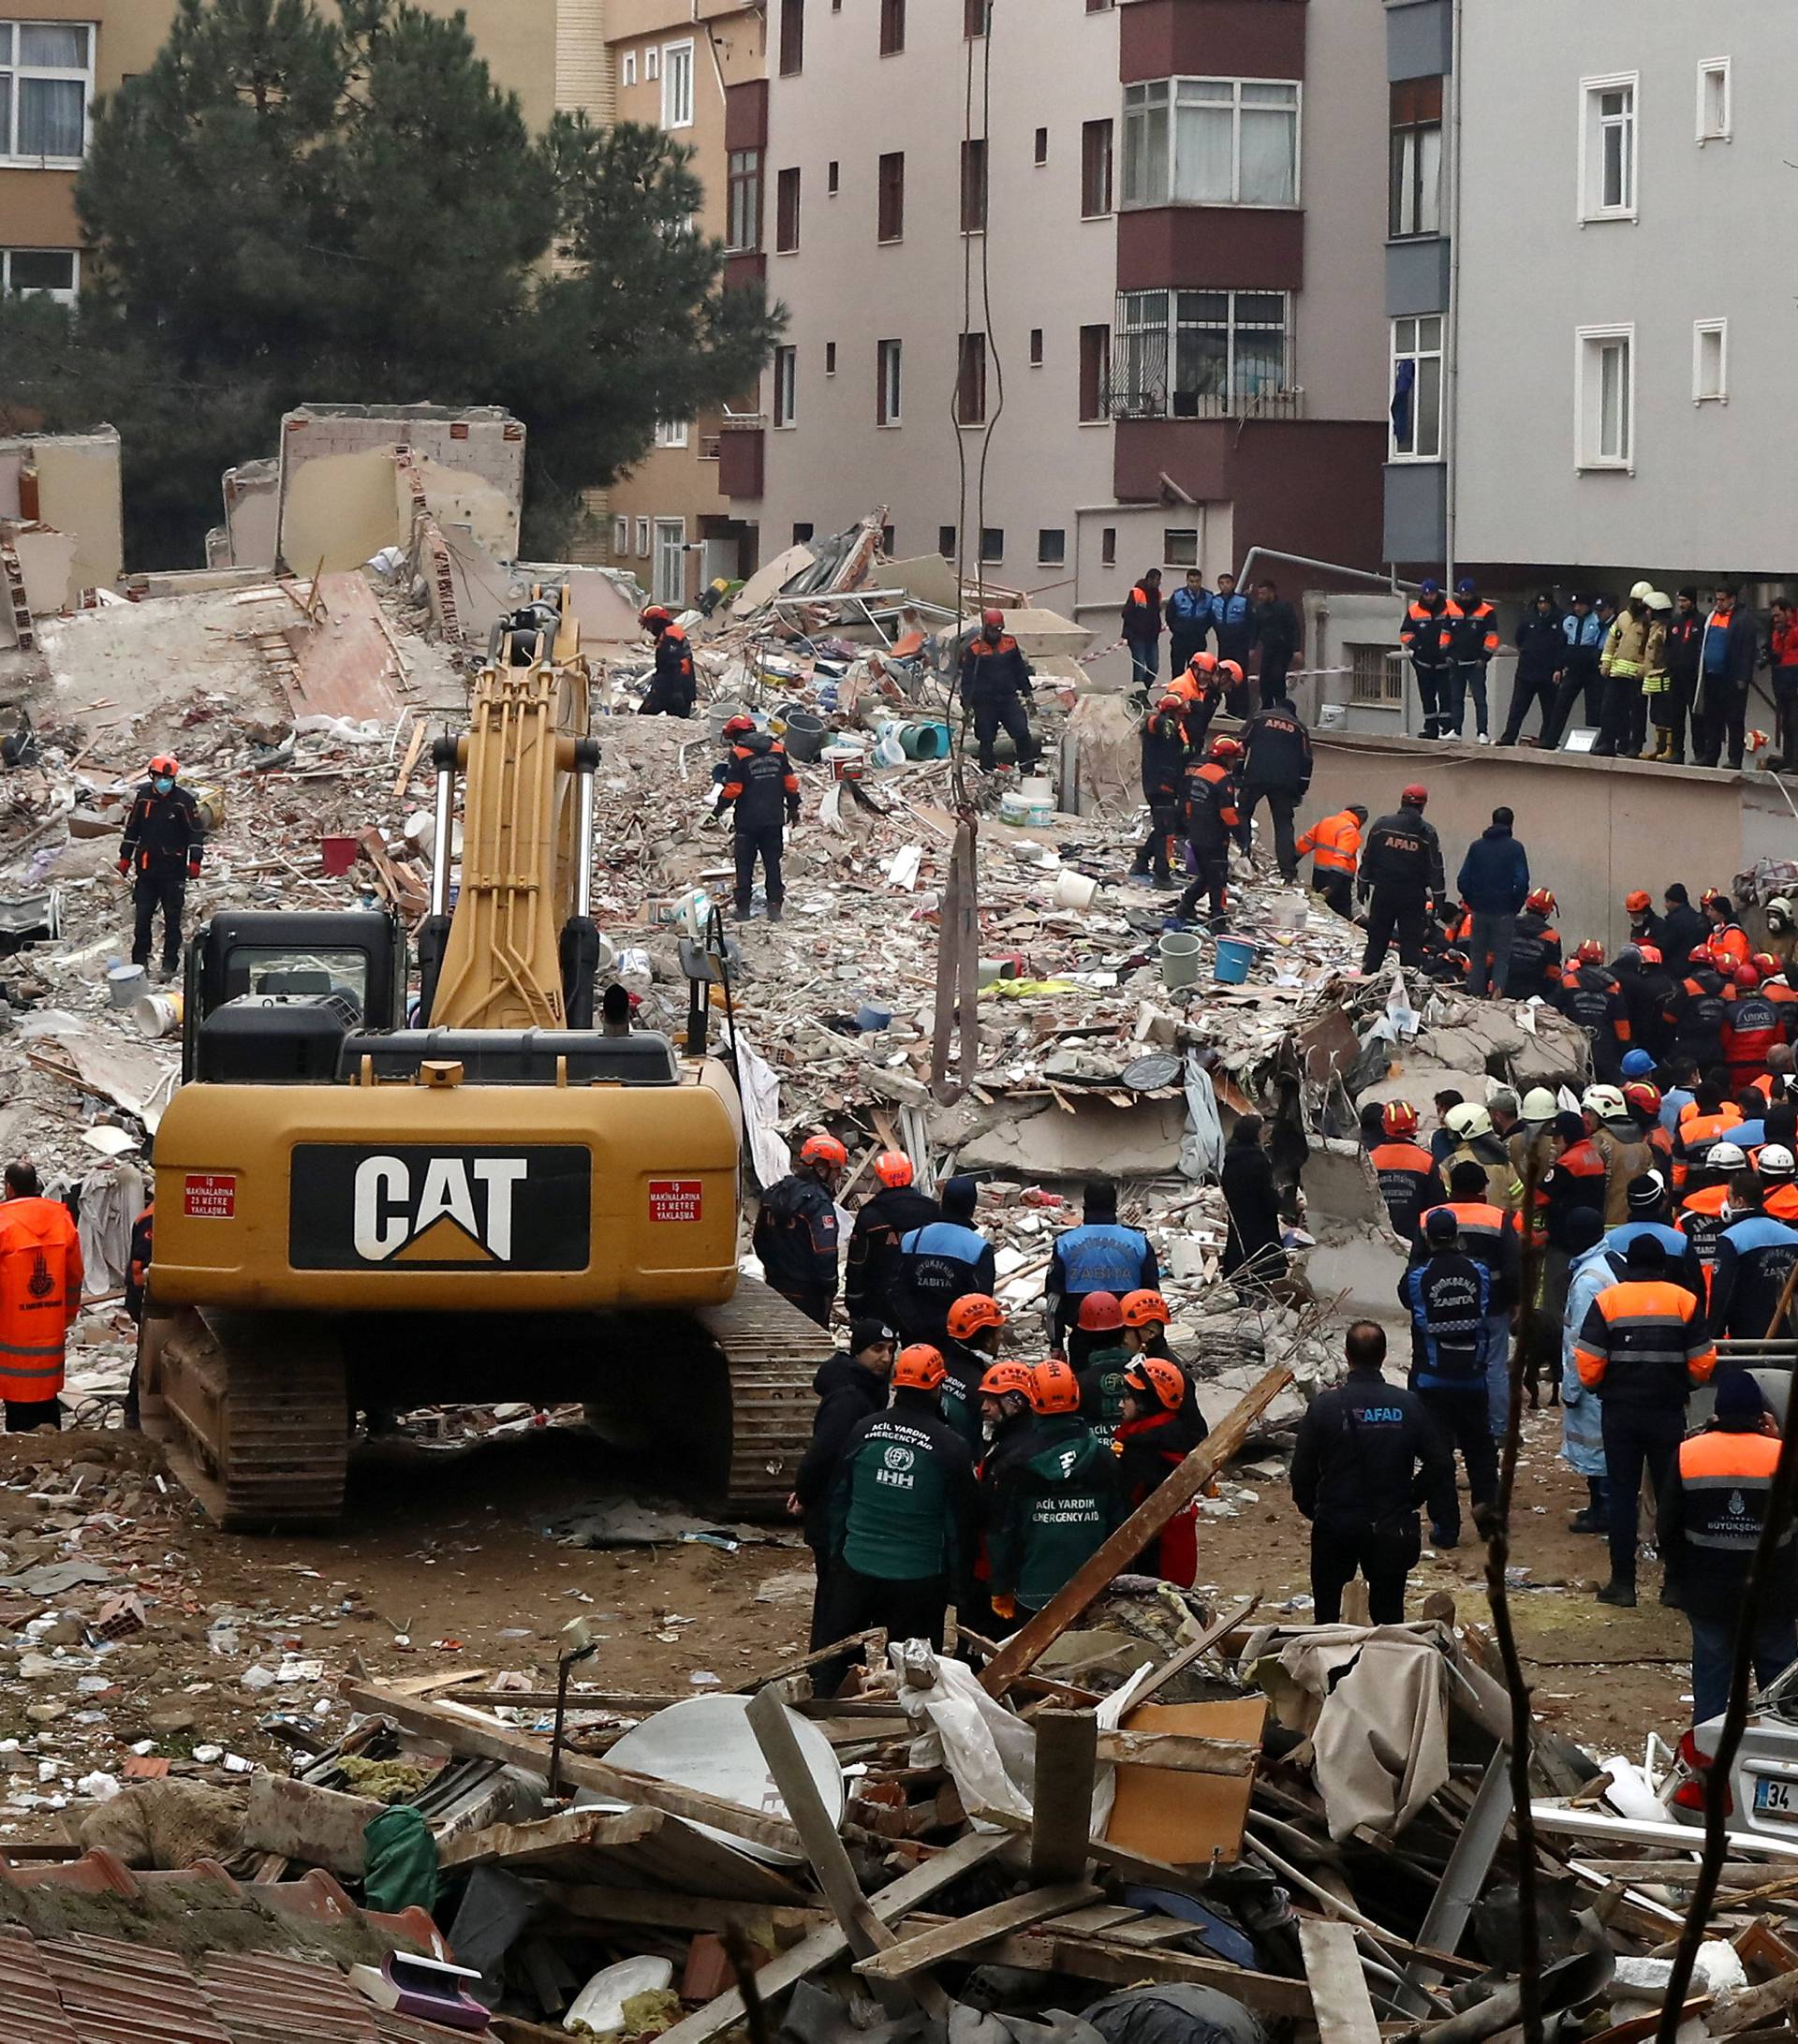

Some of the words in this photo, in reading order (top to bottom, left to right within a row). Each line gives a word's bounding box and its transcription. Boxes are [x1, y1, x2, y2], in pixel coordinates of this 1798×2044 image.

[1385, 836, 1420, 852] AFAD
[201, 1197, 228, 1206] METRE
[354, 1155, 528, 1261] CAT
[656, 1201, 666, 1211] 25
[668, 1201, 695, 1211] METRE
[917, 1277, 952, 1288] ZABITA
[1363, 1407, 1404, 1422] AFAD
[864, 1431, 918, 1444] EMERGENCY
[917, 1440, 934, 1450] AID
[894, 1424, 931, 1442] YARDIM
[1058, 1498, 1095, 1509] YARDIM
[1032, 1511, 1083, 1523] EMERGENCY
[1083, 1510, 1099, 1522] AID
[1768, 1783, 1790, 1810] 34
